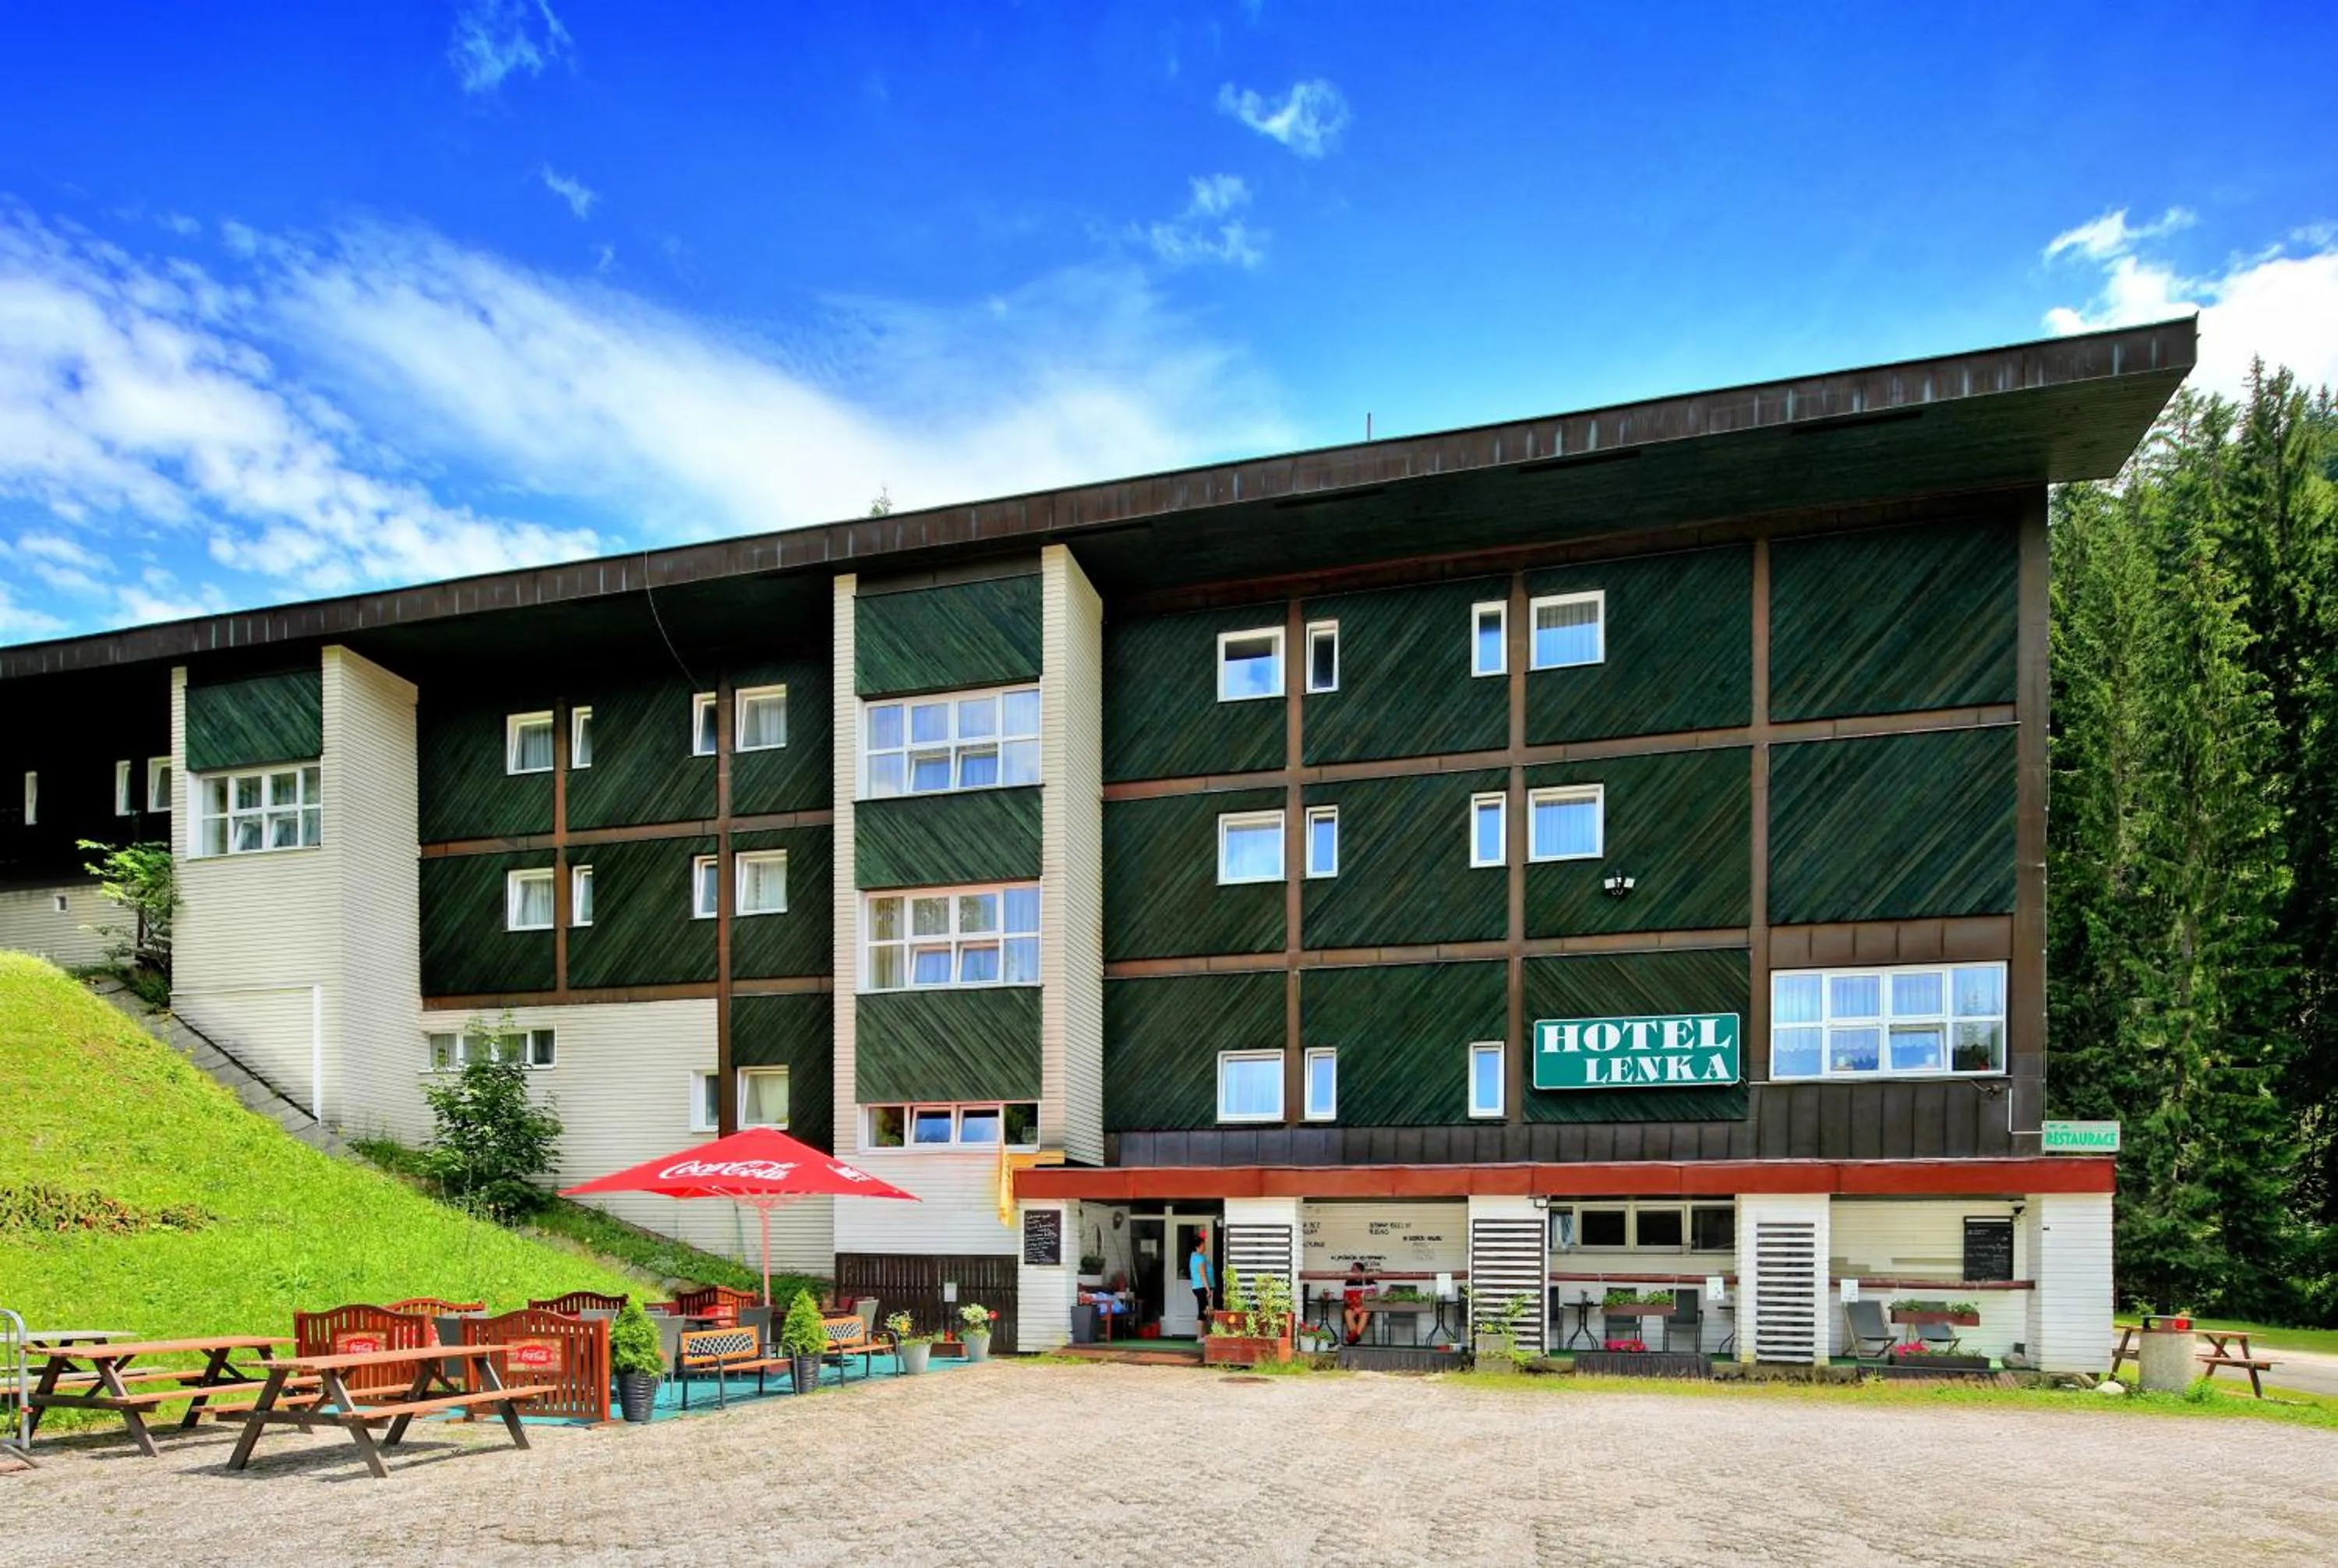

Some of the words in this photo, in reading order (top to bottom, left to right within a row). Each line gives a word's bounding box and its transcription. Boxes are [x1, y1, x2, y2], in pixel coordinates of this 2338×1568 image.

[1541, 1019, 1732, 1053] HOTEL
[1584, 1053, 1732, 1084] LENKA
[2045, 1132, 2117, 1146] RESTAURACE
